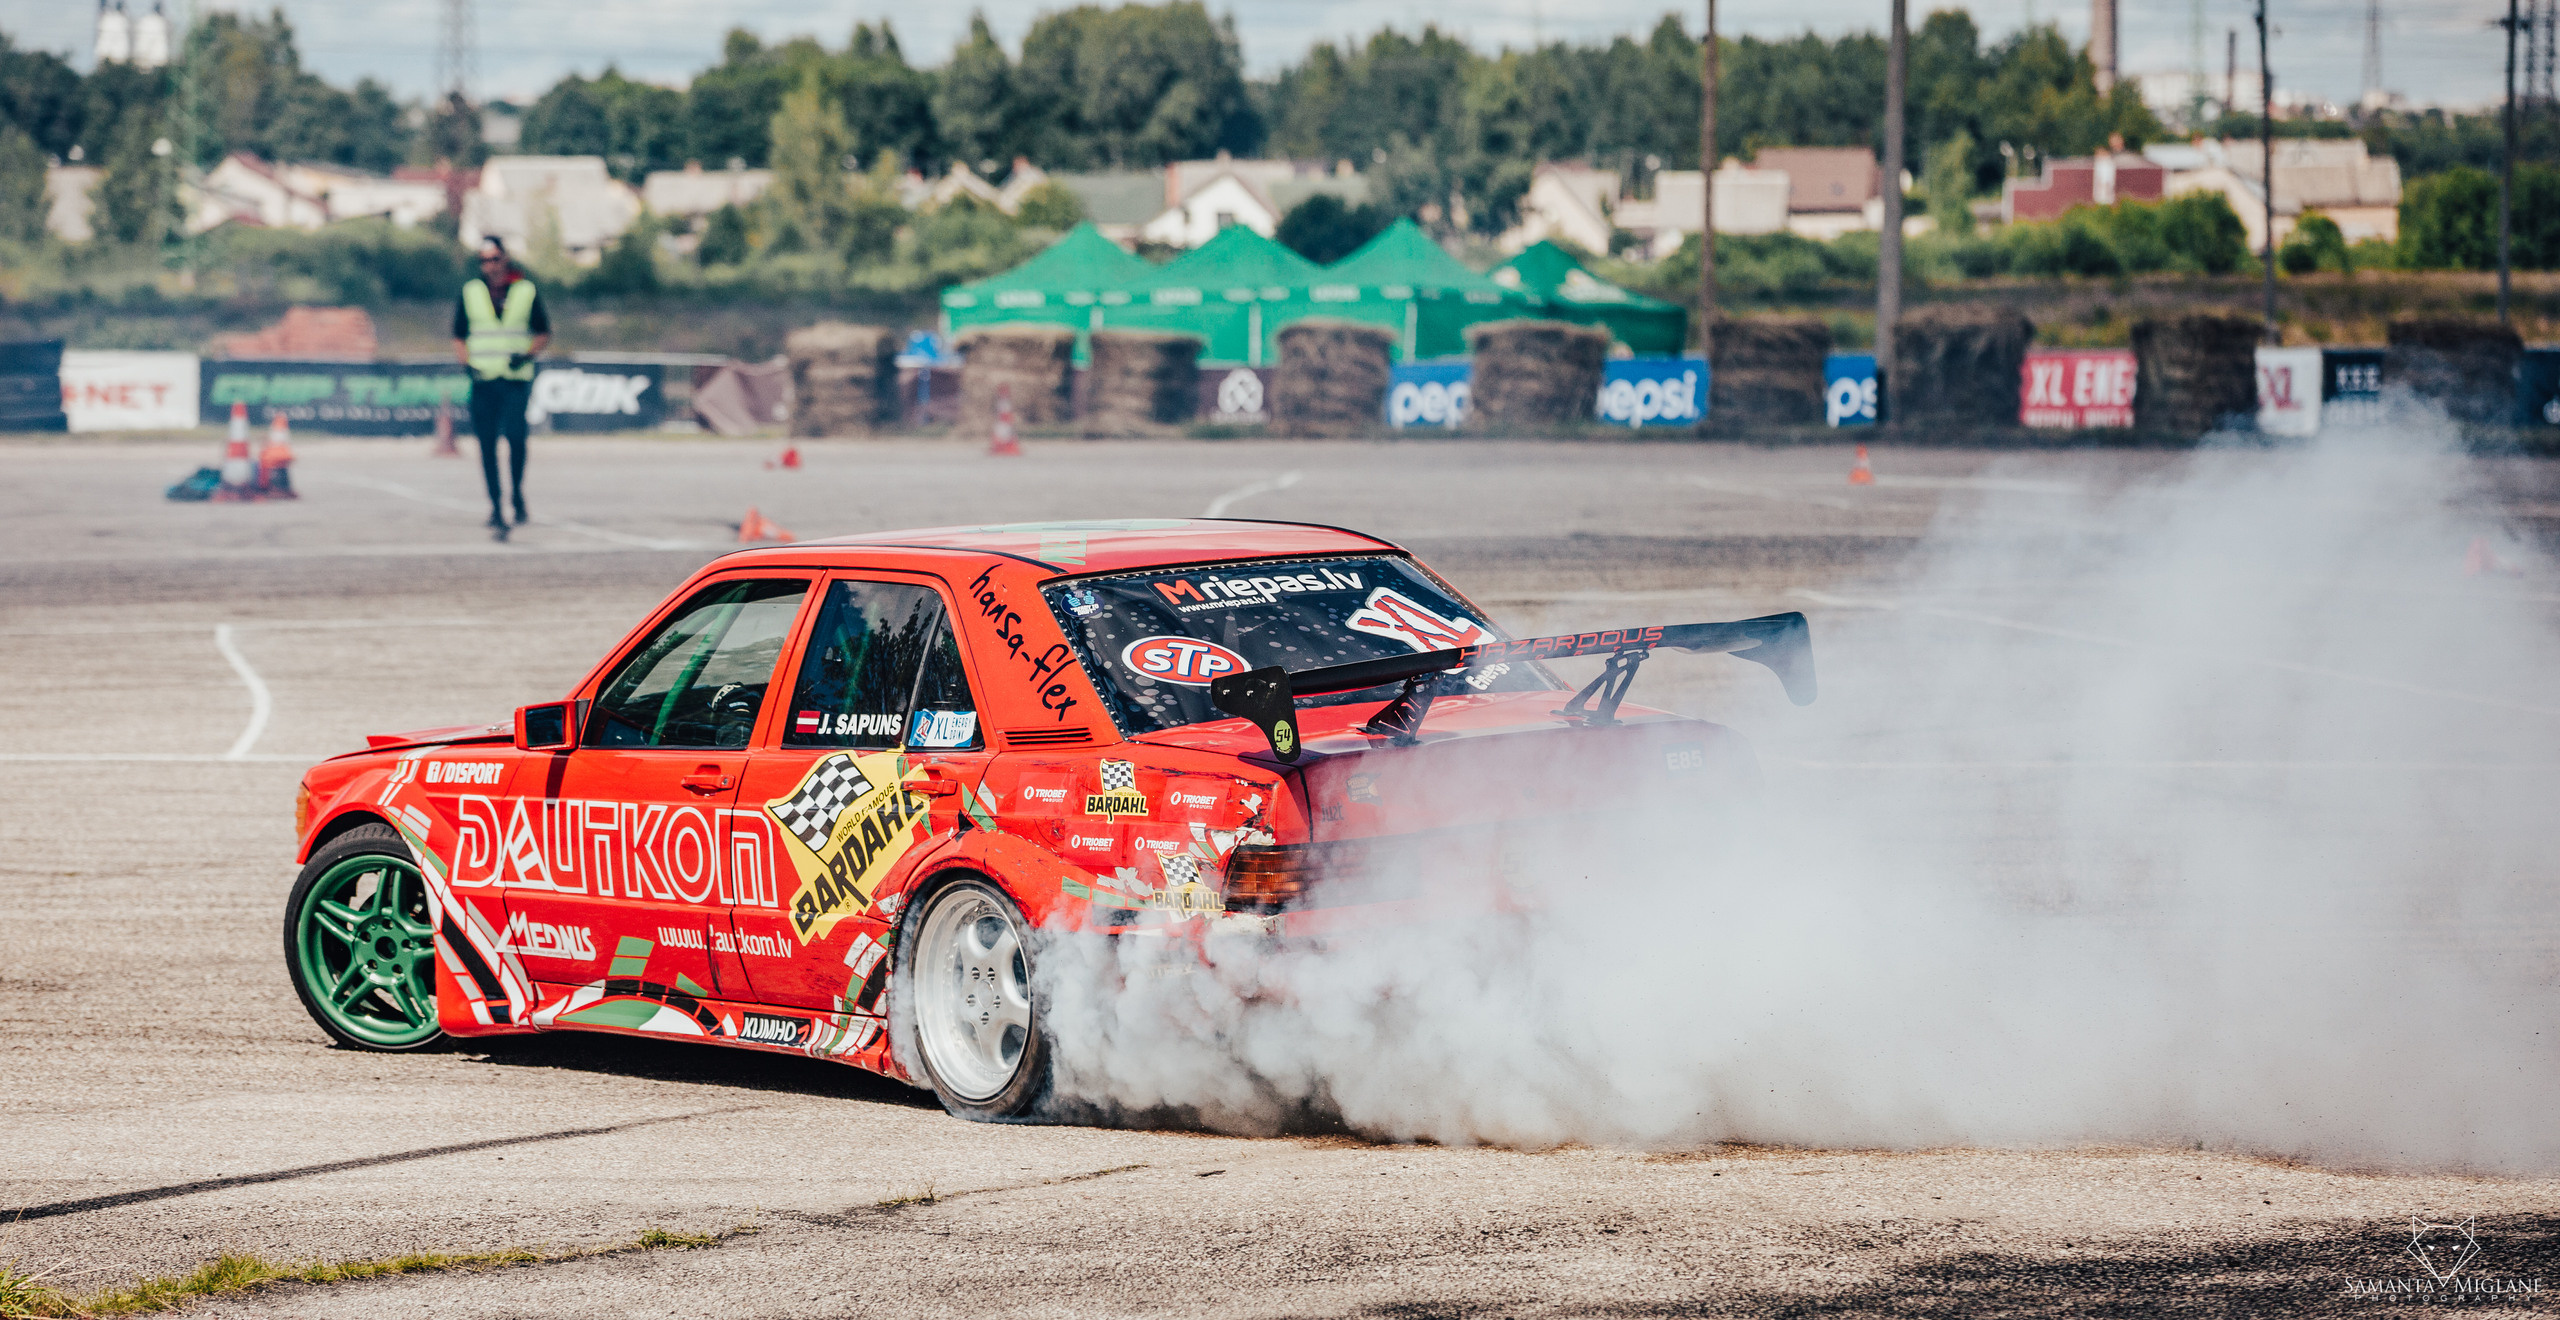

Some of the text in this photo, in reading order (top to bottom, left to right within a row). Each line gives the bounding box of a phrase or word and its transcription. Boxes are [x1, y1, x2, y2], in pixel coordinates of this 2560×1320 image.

[1459, 626, 1665, 660] HAZARDOUS
[1142, 642, 1234, 677] STP
[818, 713, 902, 736] J. SAPUNS
[934, 717, 972, 740] XL ENERGY
[1276, 728, 1291, 742] 54
[1665, 750, 1703, 770] E85
[1035, 788, 1067, 799] TRIOBET
[1182, 794, 1217, 805] TRIOBET
[836, 782, 895, 842] WORLD FAMOUS
[1087, 796, 1147, 820] BARDAHL
[1082, 837, 1114, 847] TRIOBET
[1146, 840, 1179, 850] TRIOBET
[795, 791, 925, 936] BARDAHL
[1154, 892, 1225, 916] BARDAHL
[740, 1016, 797, 1042] KUMHO
